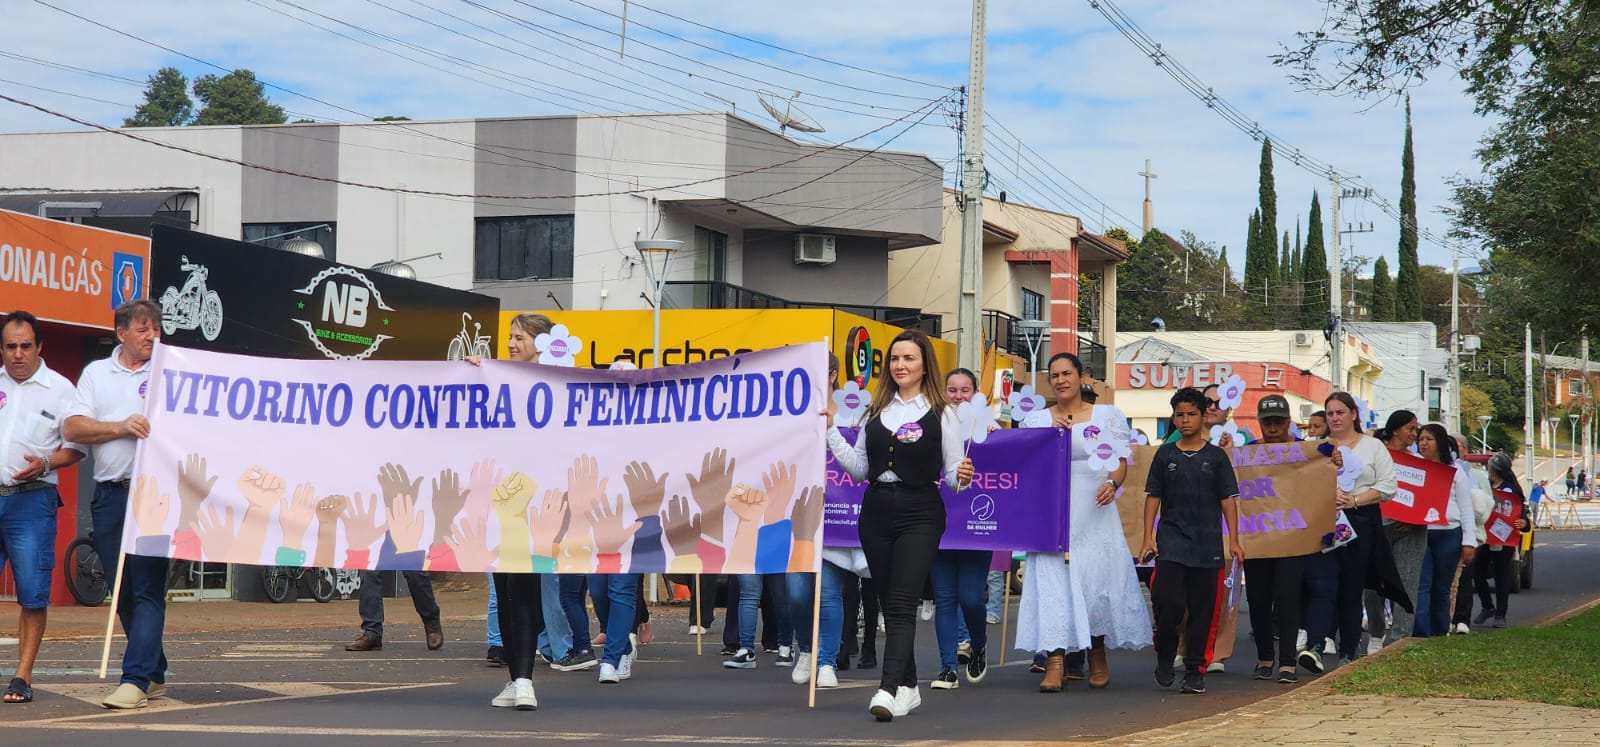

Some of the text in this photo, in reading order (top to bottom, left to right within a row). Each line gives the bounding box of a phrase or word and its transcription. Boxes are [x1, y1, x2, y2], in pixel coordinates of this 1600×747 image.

[322, 280, 370, 328] NB
[1129, 363, 1234, 389] SUPER
[163, 358, 811, 430] VITORINO CONTRA O FEMINICÍDIO
[1231, 443, 1308, 469] MATA
[1235, 476, 1276, 501] OR
